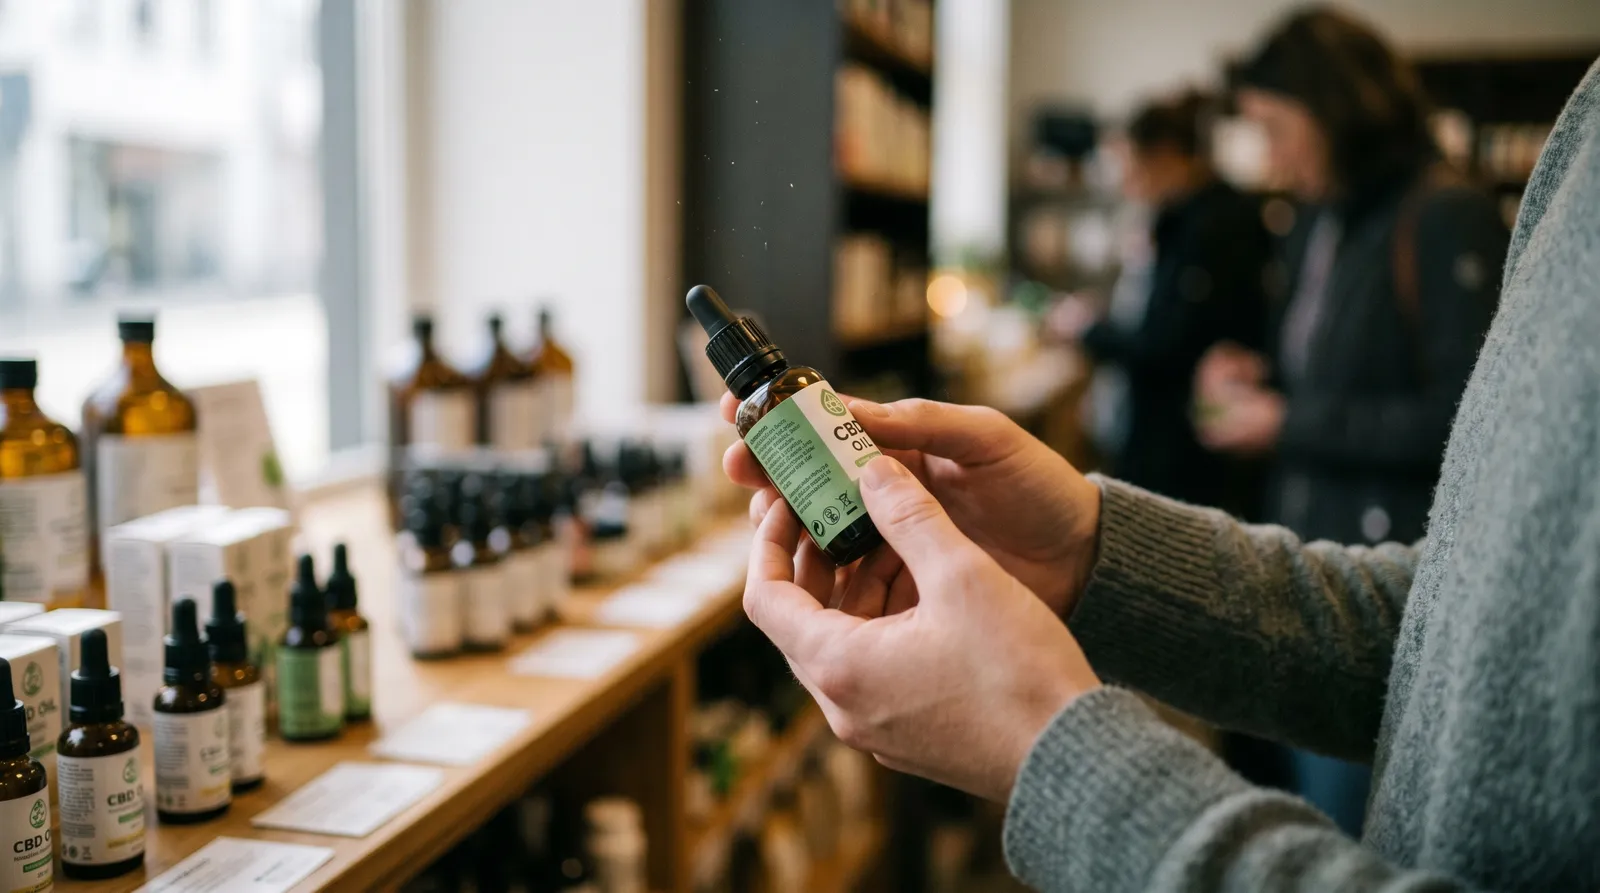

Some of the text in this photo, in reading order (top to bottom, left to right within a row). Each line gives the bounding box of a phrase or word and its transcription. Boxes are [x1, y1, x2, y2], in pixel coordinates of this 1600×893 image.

[833, 420, 864, 441] CBD
[852, 436, 873, 451] OIL
[107, 789, 135, 807] CBD
[13, 834, 43, 854] CBD
